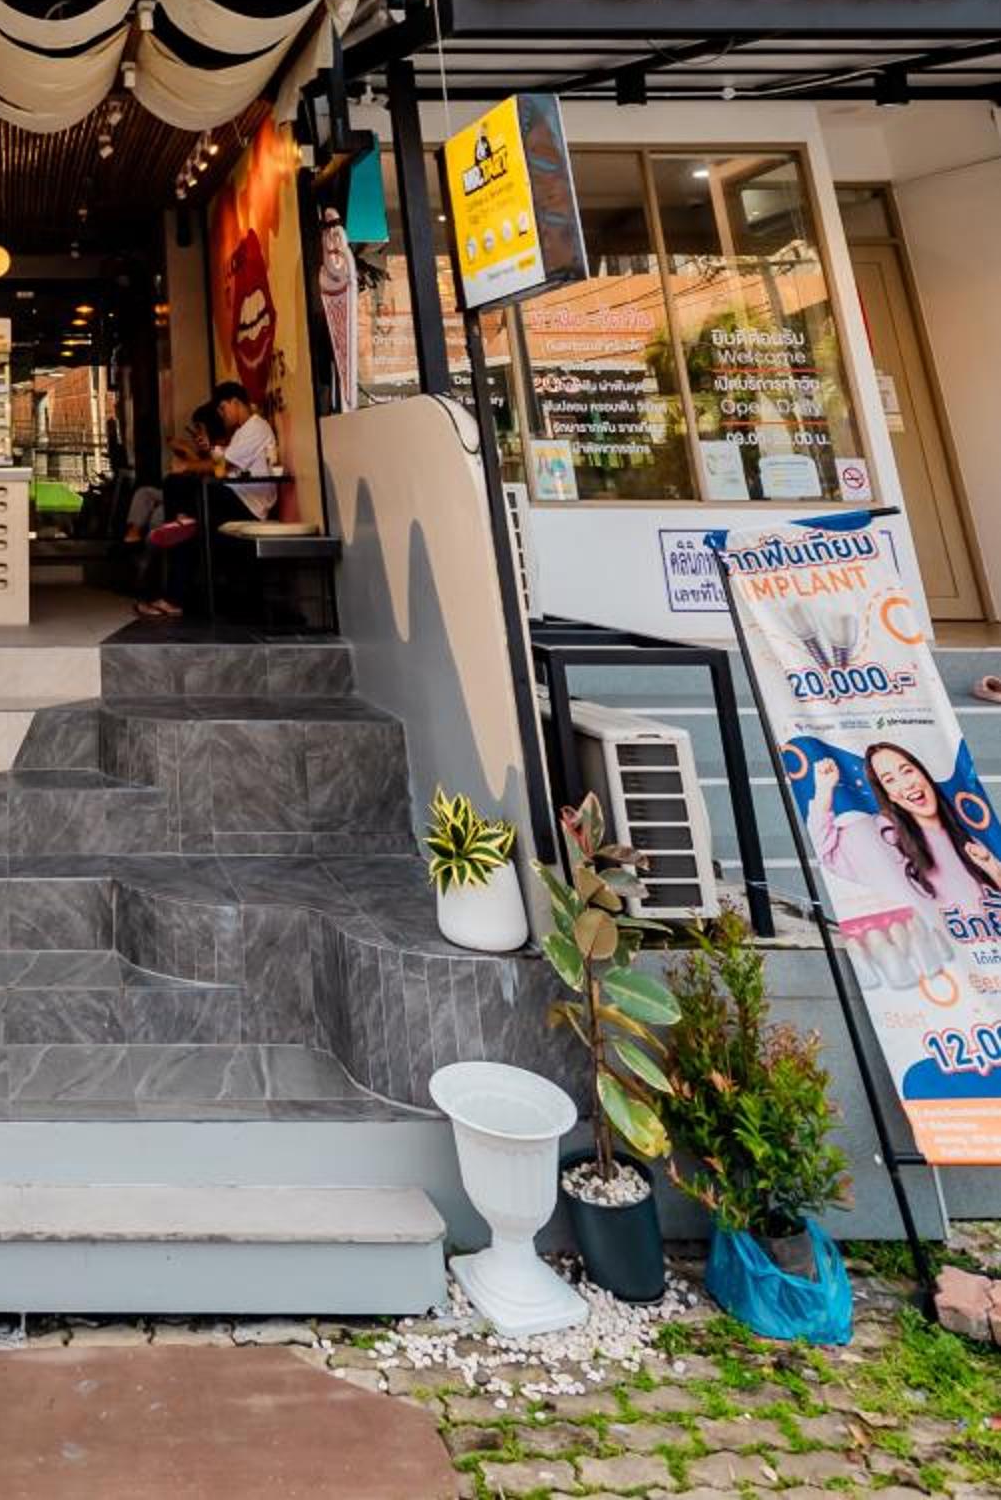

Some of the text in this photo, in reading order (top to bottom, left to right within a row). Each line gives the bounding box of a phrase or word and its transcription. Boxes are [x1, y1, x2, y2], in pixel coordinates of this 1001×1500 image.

[718, 350, 806, 364] Welcome
[742, 566, 868, 601] IMPLANT
[788, 667, 912, 698] 20,000.-
[928, 1033, 1001, 1068] 12,0
